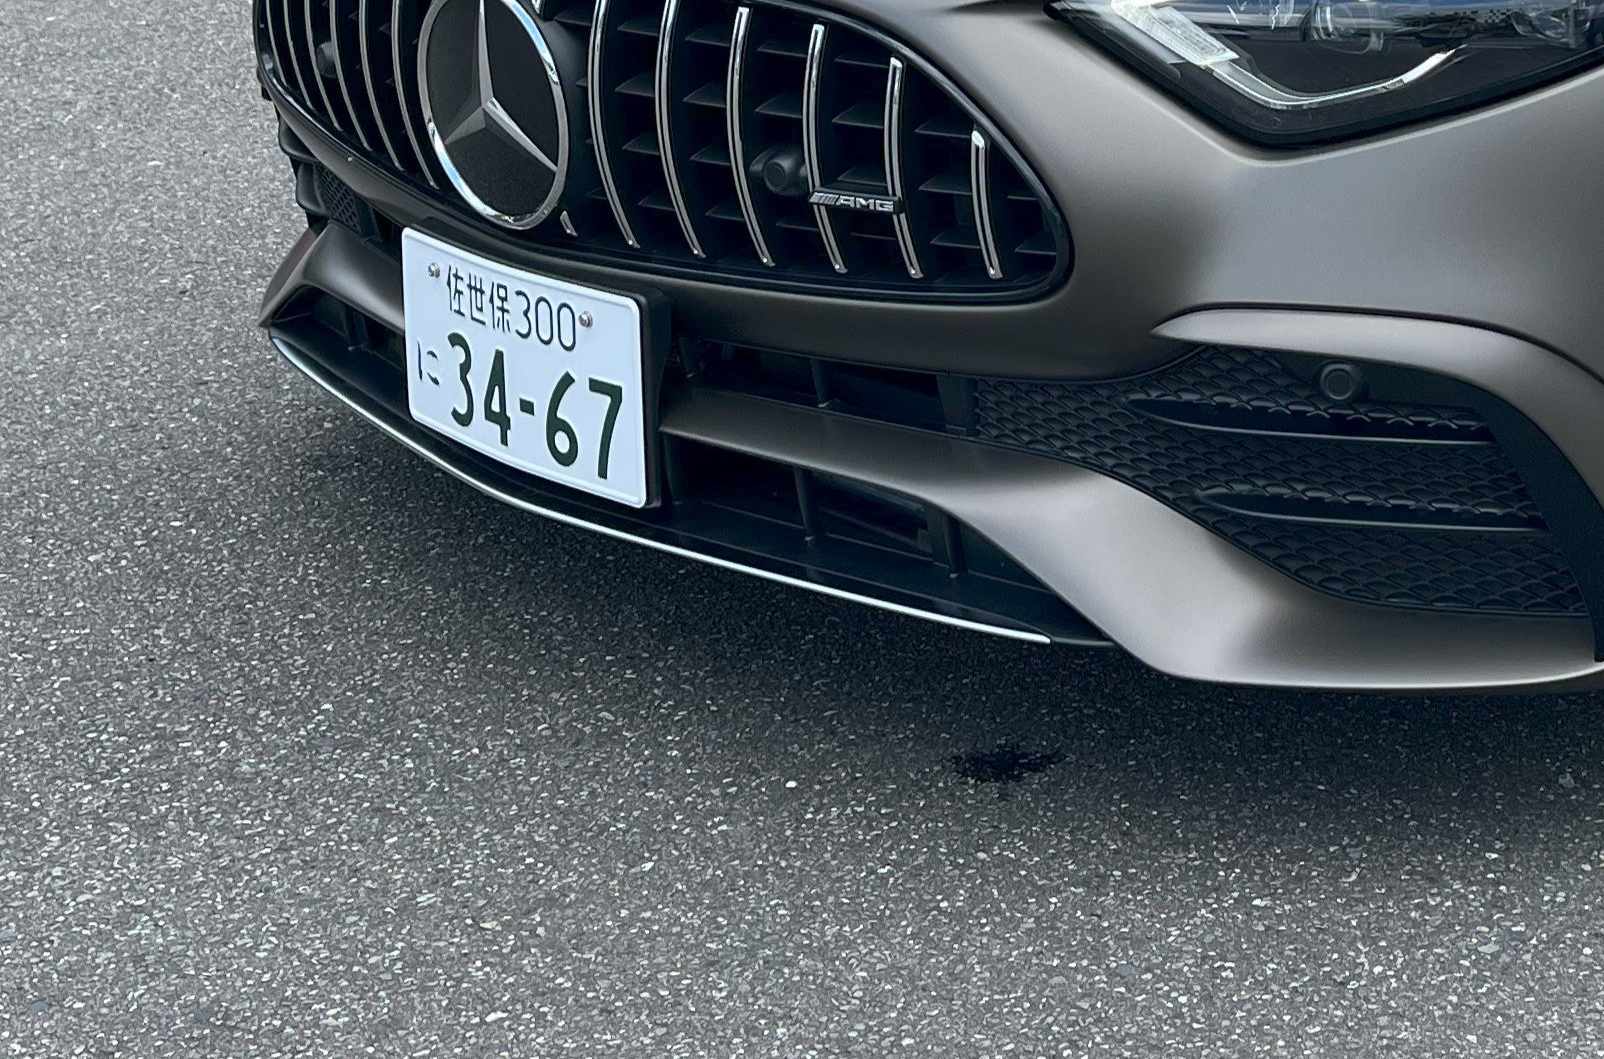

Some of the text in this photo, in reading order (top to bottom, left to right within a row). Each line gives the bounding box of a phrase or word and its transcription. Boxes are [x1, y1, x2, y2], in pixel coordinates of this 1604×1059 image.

[446, 263, 578, 352] 佐世保300
[416, 331, 624, 480] に 34-67
